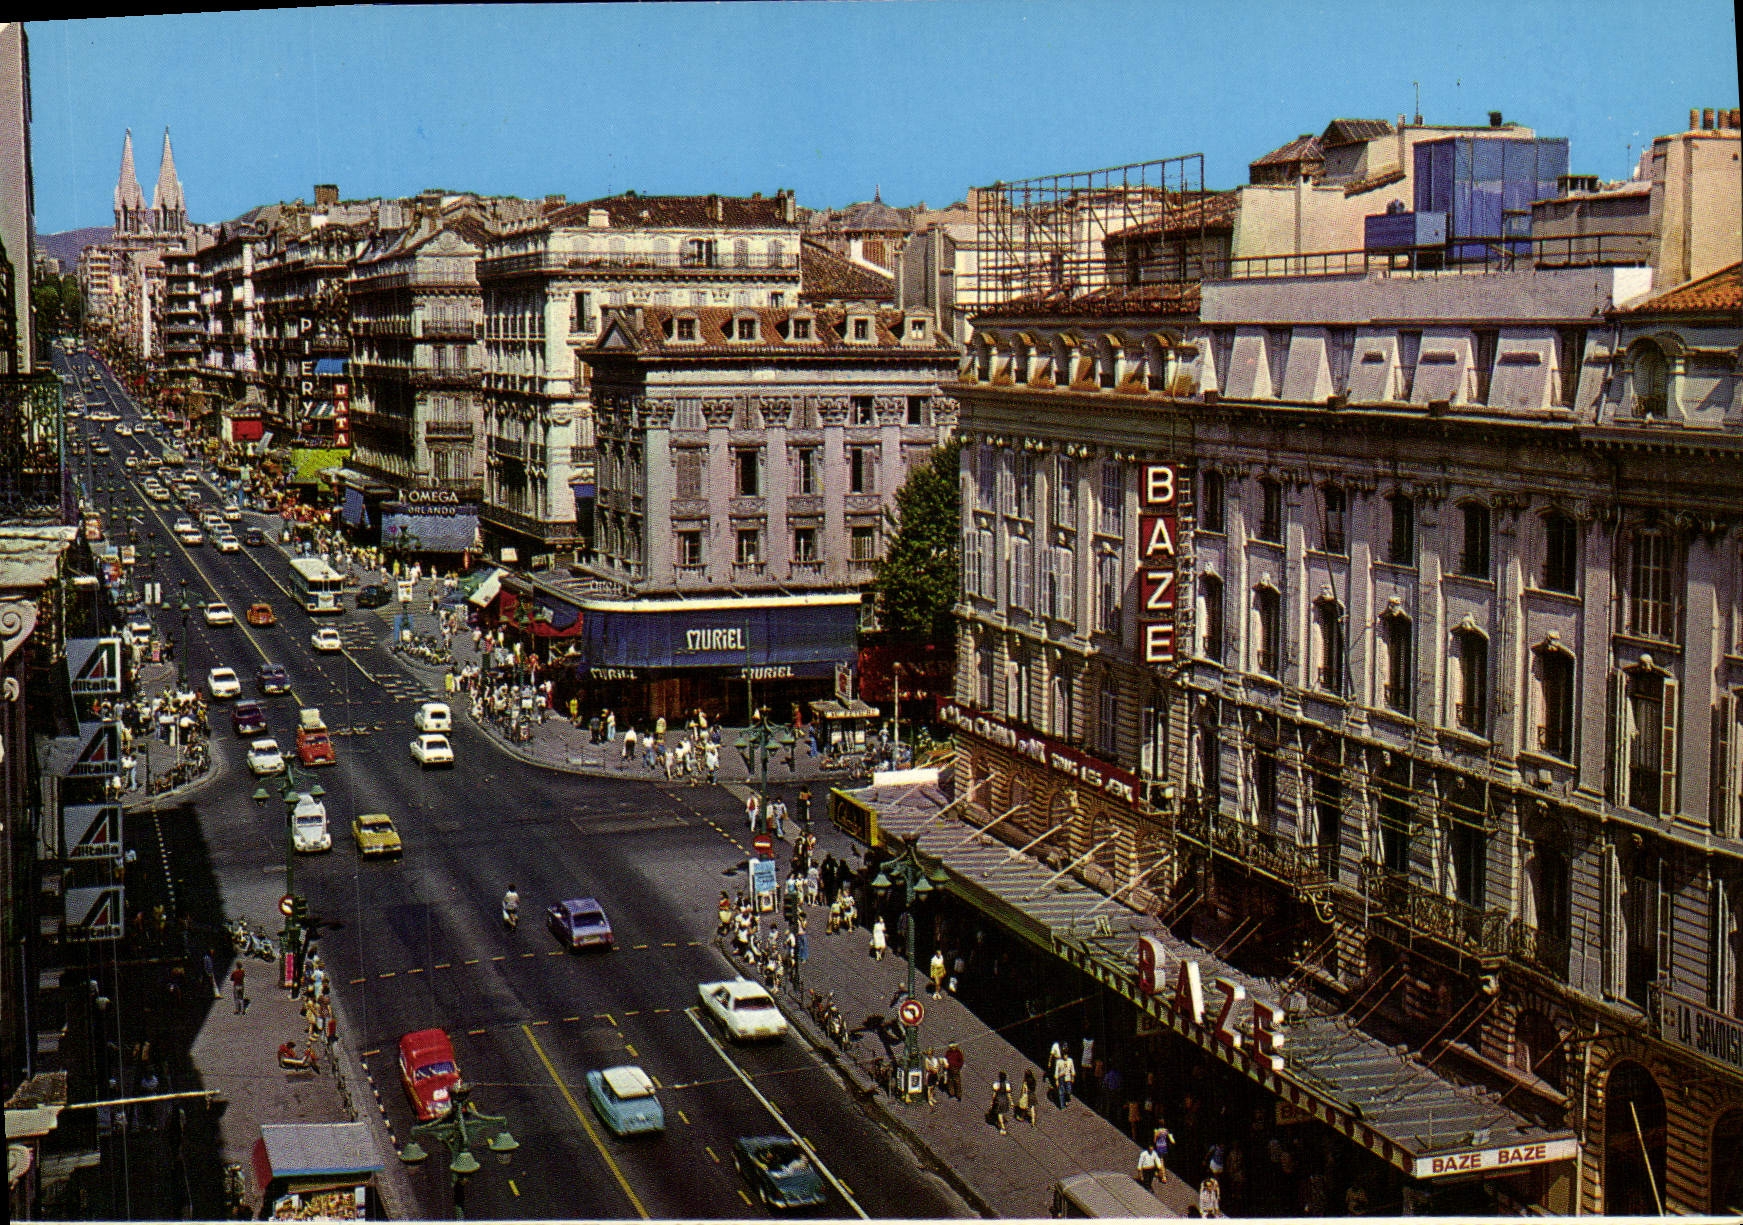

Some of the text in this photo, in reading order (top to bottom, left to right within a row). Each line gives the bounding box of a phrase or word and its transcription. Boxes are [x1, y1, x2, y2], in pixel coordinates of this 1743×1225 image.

[408, 490, 459, 503] OMEGA
[408, 505, 456, 515] ORLANDO
[1146, 466, 1175, 662] BAZE
[1138, 935, 1284, 1071] BAZE
[1679, 1004, 1691, 1046] LA
[1432, 1145, 1546, 1174] BAZE BAZE
